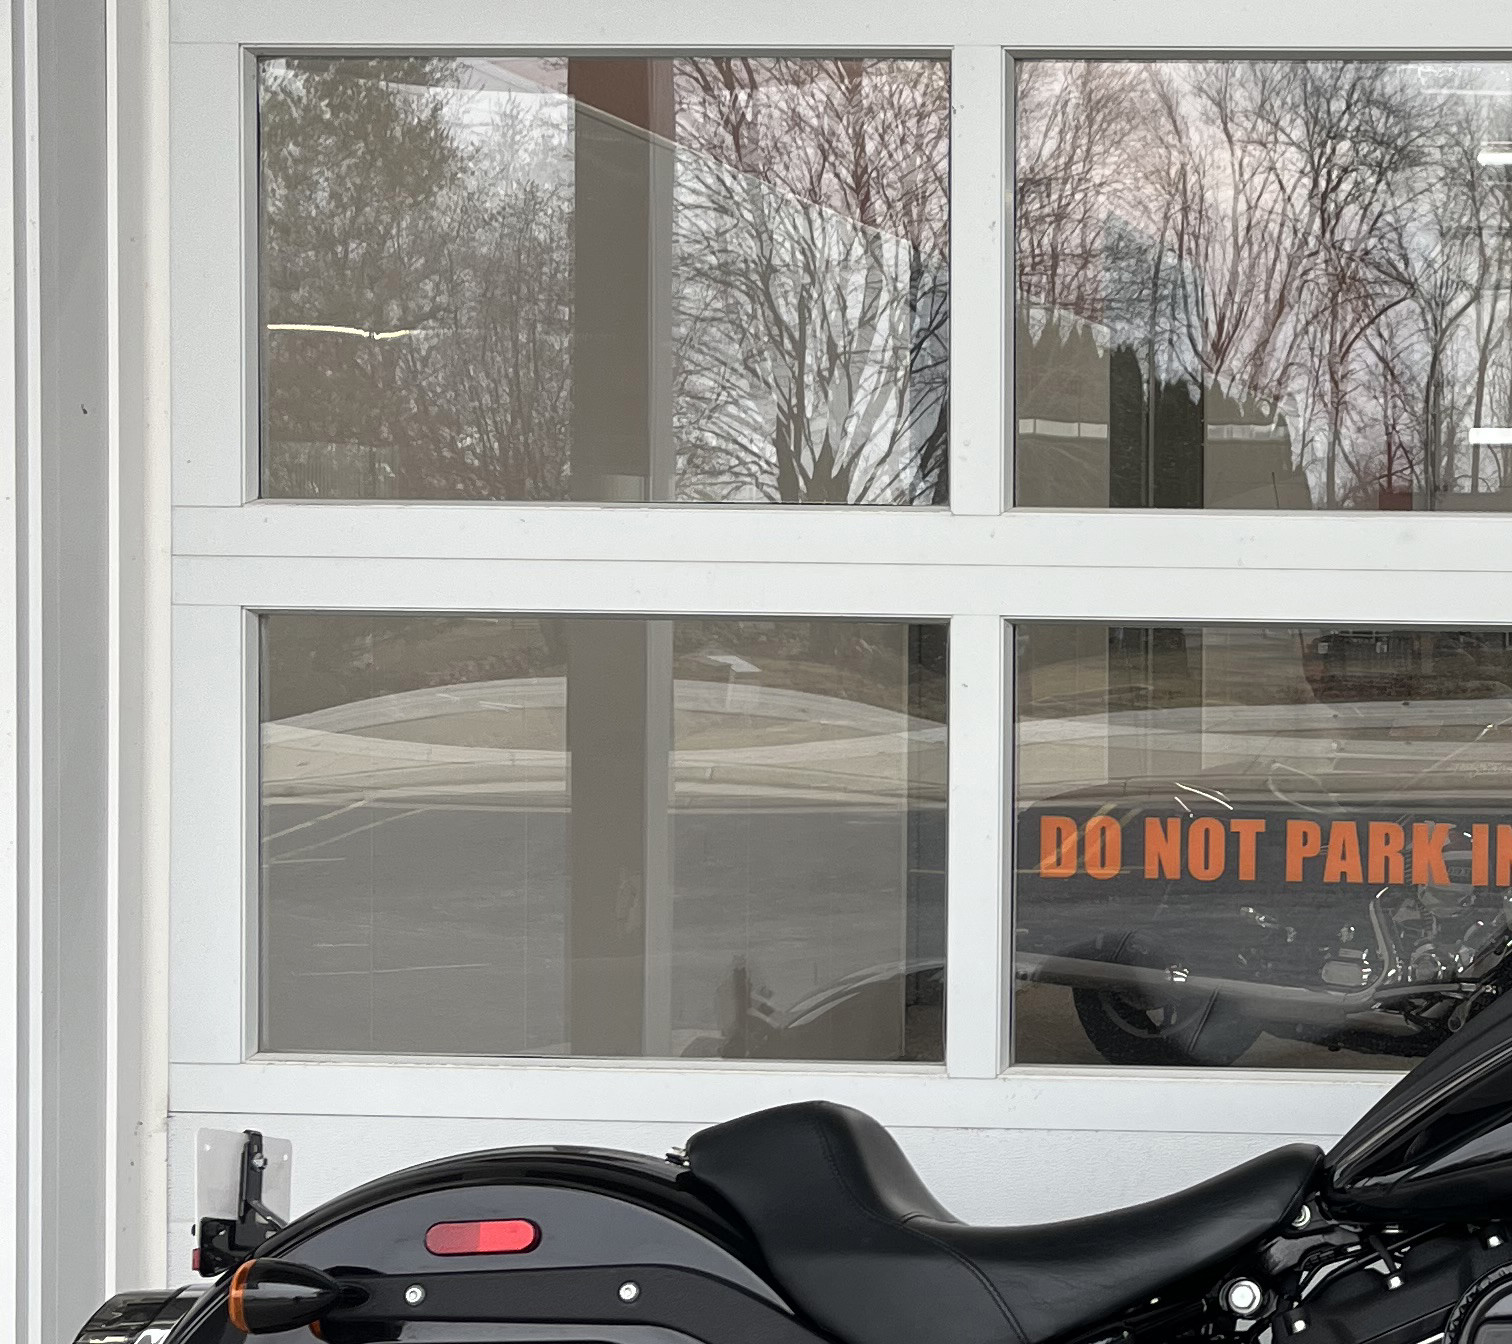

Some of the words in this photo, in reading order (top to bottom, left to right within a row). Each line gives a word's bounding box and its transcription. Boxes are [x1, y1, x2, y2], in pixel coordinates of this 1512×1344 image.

[1039, 815, 1122, 881] DO
[1144, 816, 1267, 882] NOT
[1285, 819, 1450, 886] PARK
